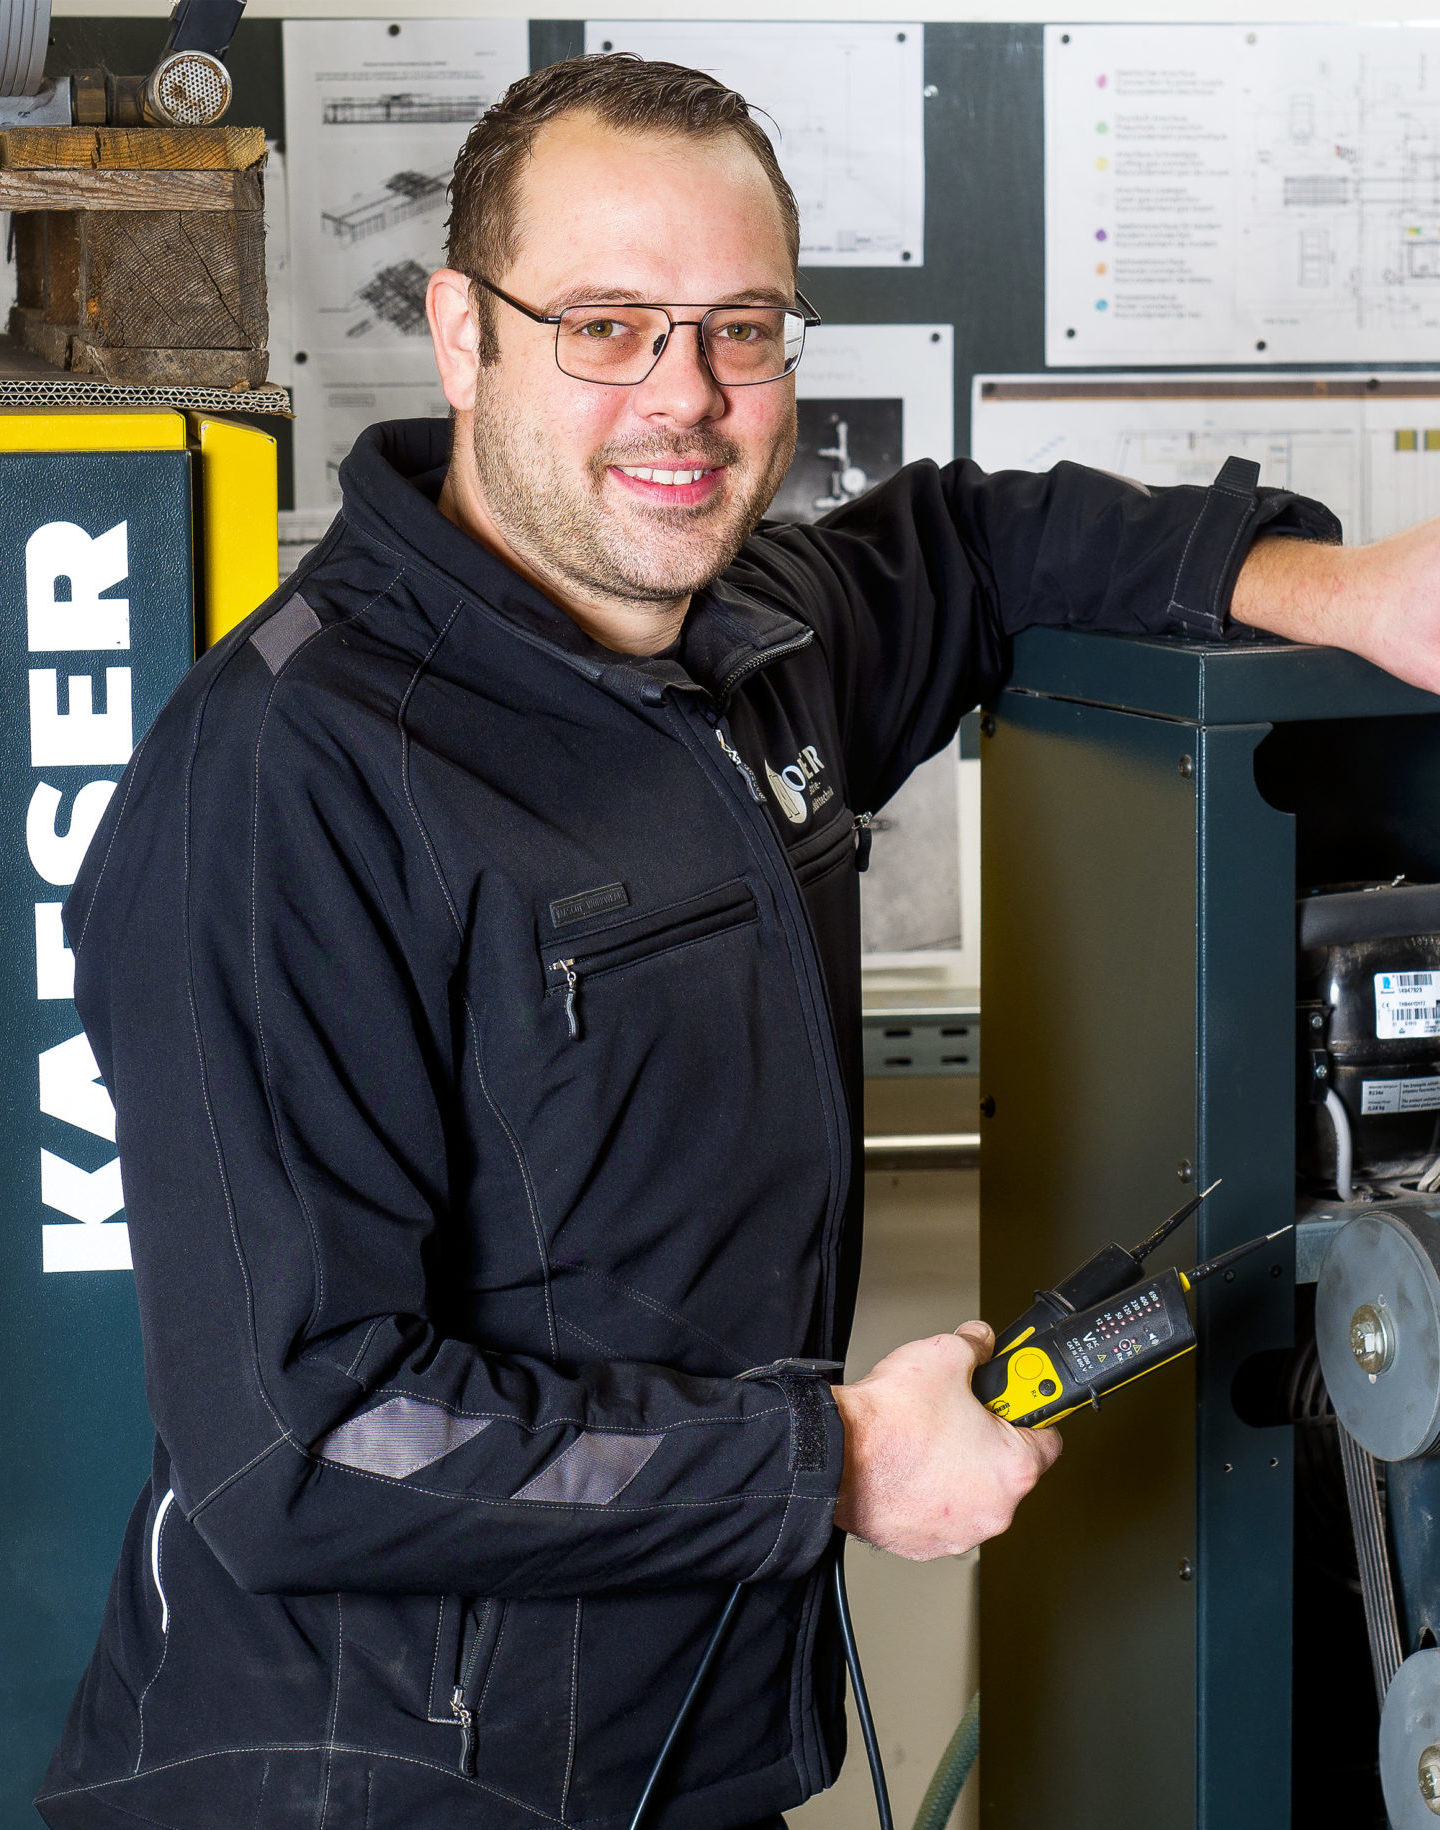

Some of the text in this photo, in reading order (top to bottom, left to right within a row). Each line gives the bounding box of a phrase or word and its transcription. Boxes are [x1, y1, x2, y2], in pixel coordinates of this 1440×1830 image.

[1140, 1296, 1149, 1306] 400
[1148, 1291, 1159, 1301] 690
[1123, 1305, 1132, 1315] 120
[1130, 1300, 1141, 1311] 230
[1115, 1312, 1123, 1320] 50
[1096, 1318, 1103, 1326] 12
